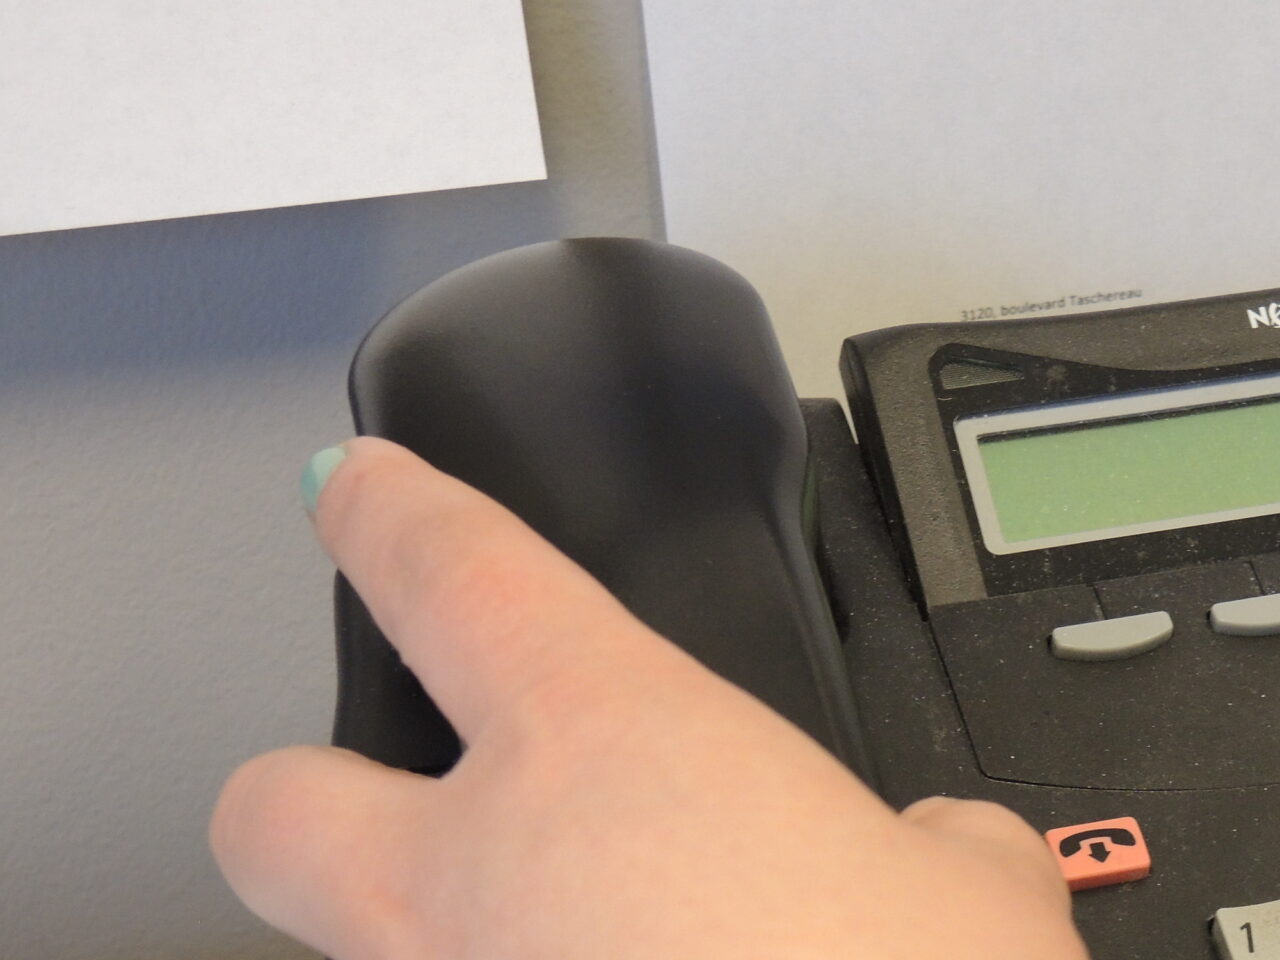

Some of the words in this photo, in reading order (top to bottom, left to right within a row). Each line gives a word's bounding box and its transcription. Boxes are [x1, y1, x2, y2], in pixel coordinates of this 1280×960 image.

[1001, 296, 1065, 316] boulevard
[1070, 289, 1142, 306] Taschereau
[1240, 922, 1255, 953] 1
